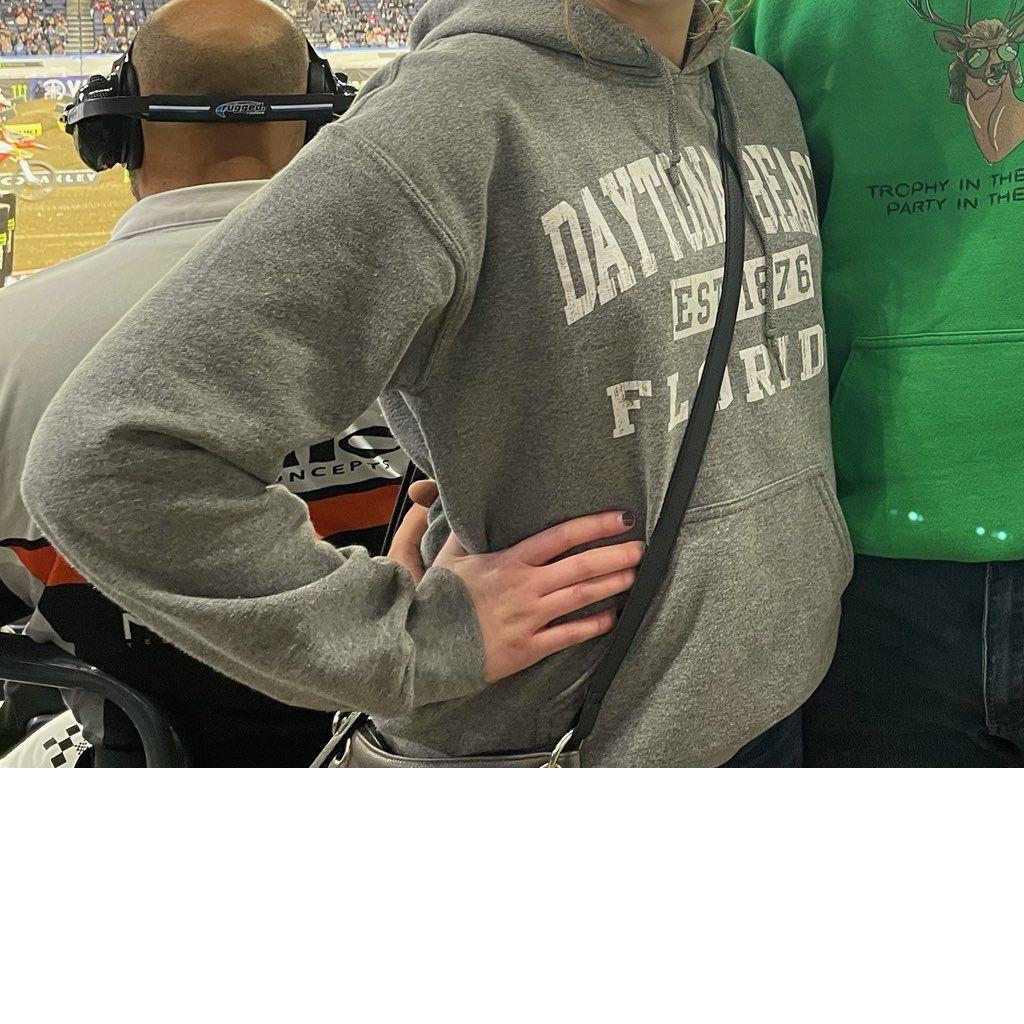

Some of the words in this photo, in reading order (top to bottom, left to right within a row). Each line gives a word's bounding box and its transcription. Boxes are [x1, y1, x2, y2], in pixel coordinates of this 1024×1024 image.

[867, 179, 950, 199] TROPHY
[959, 178, 981, 192] IN
[886, 198, 947, 216] PARTY
[957, 196, 978, 210] IN
[989, 187, 1024, 206] THE
[541, 145, 727, 326] DAYTON
[674, 279, 724, 333] ES
[606, 324, 825, 438] FLRID
[275, 459, 390, 484] NCEPTS
